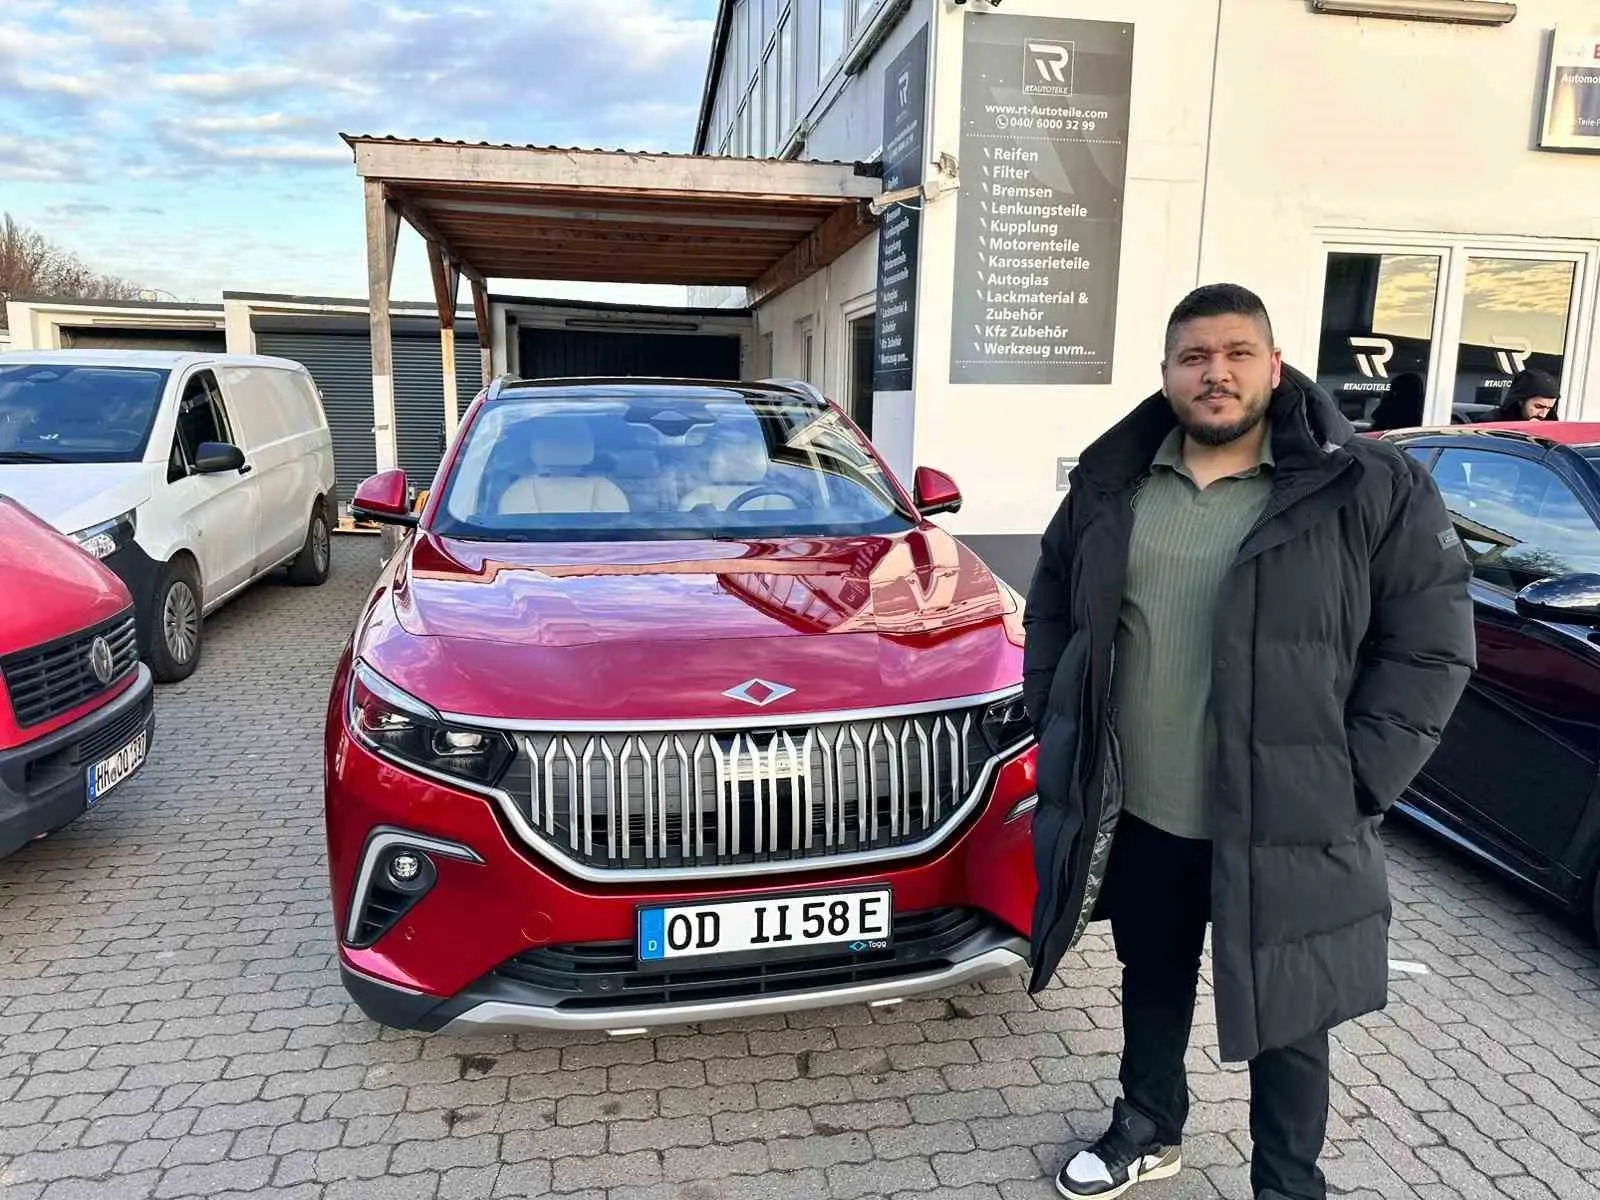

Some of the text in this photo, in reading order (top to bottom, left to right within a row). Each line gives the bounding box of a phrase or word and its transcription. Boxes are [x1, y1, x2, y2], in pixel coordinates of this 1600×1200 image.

[984, 104, 1108, 119] www.rt-Autoteile.com
[1036, 118, 1063, 130] 6000
[1065, 120, 1079, 130] 32
[1081, 121, 1096, 131] 99
[993, 148, 1039, 162] Reifen
[992, 166, 1030, 179] Filter
[991, 184, 1053, 198] Bremsen
[991, 203, 1088, 218] Lenkungsteile
[990, 220, 1058, 236] Kupplung
[989, 238, 1080, 252] Motorenteile
[988, 255, 1090, 270] Karosserieteile
[987, 273, 1049, 289] Autoglas
[986, 291, 1089, 304] Lackmaterial &
[985, 308, 1044, 321] Zubehör
[984, 326, 1069, 339] Kfz Zubehör
[984, 342, 1050, 358] Werkzeug
[667, 911, 720, 950] OD
